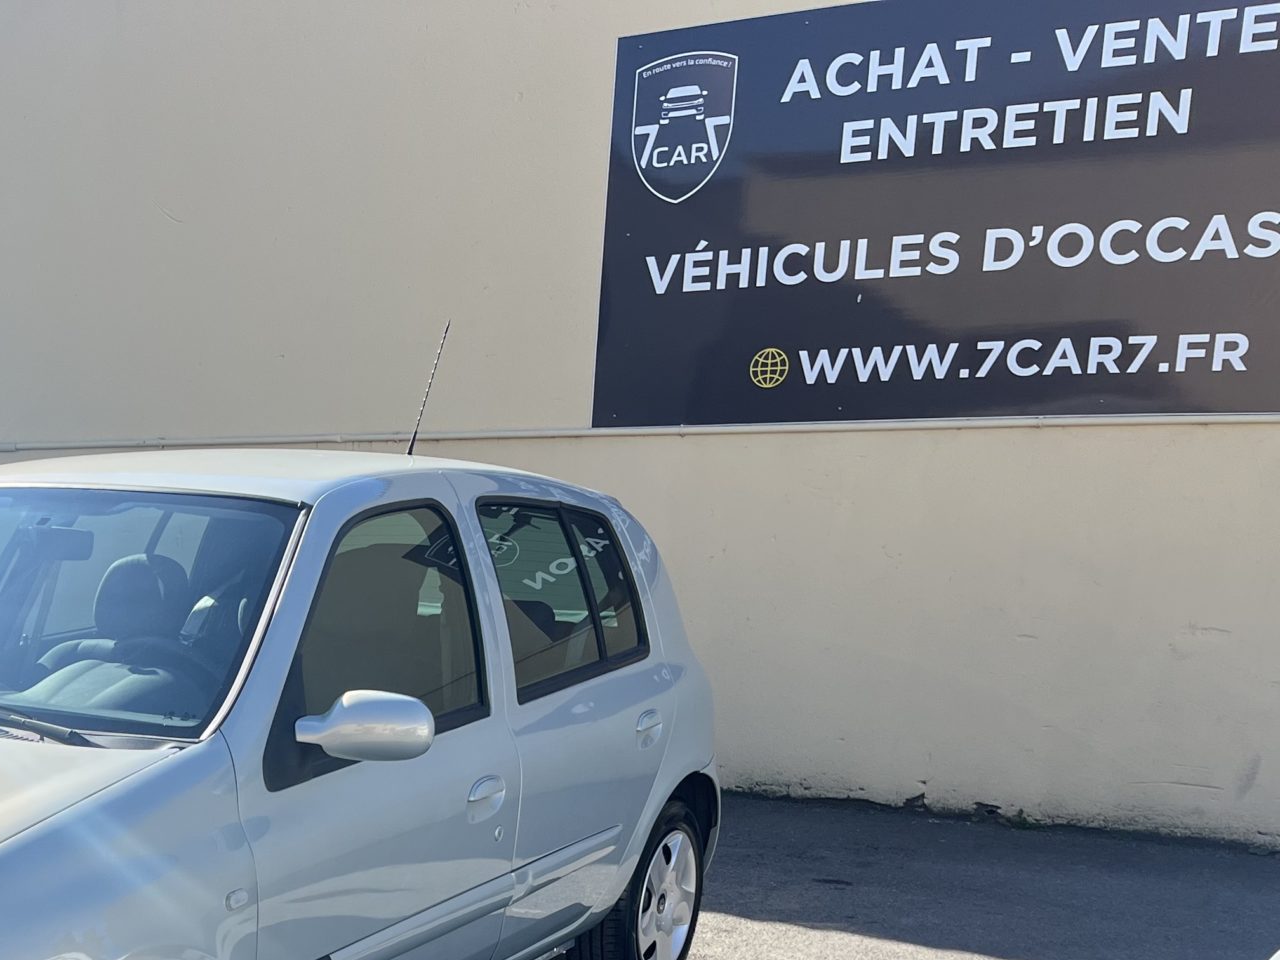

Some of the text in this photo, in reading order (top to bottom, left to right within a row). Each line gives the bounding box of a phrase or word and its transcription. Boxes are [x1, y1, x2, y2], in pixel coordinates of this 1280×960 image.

[642, 71, 652, 79] En
[652, 64, 671, 74] route
[672, 60, 687, 68] vers
[695, 57, 728, 67] confiance
[780, 37, 992, 103] ACHAT
[1054, 4, 1280, 72] VENTE
[839, 88, 1193, 164] ENTRETIEN
[645, 231, 961, 296] VÉHICULES
[798, 332, 1250, 385] WWW.7CAR7.FR
